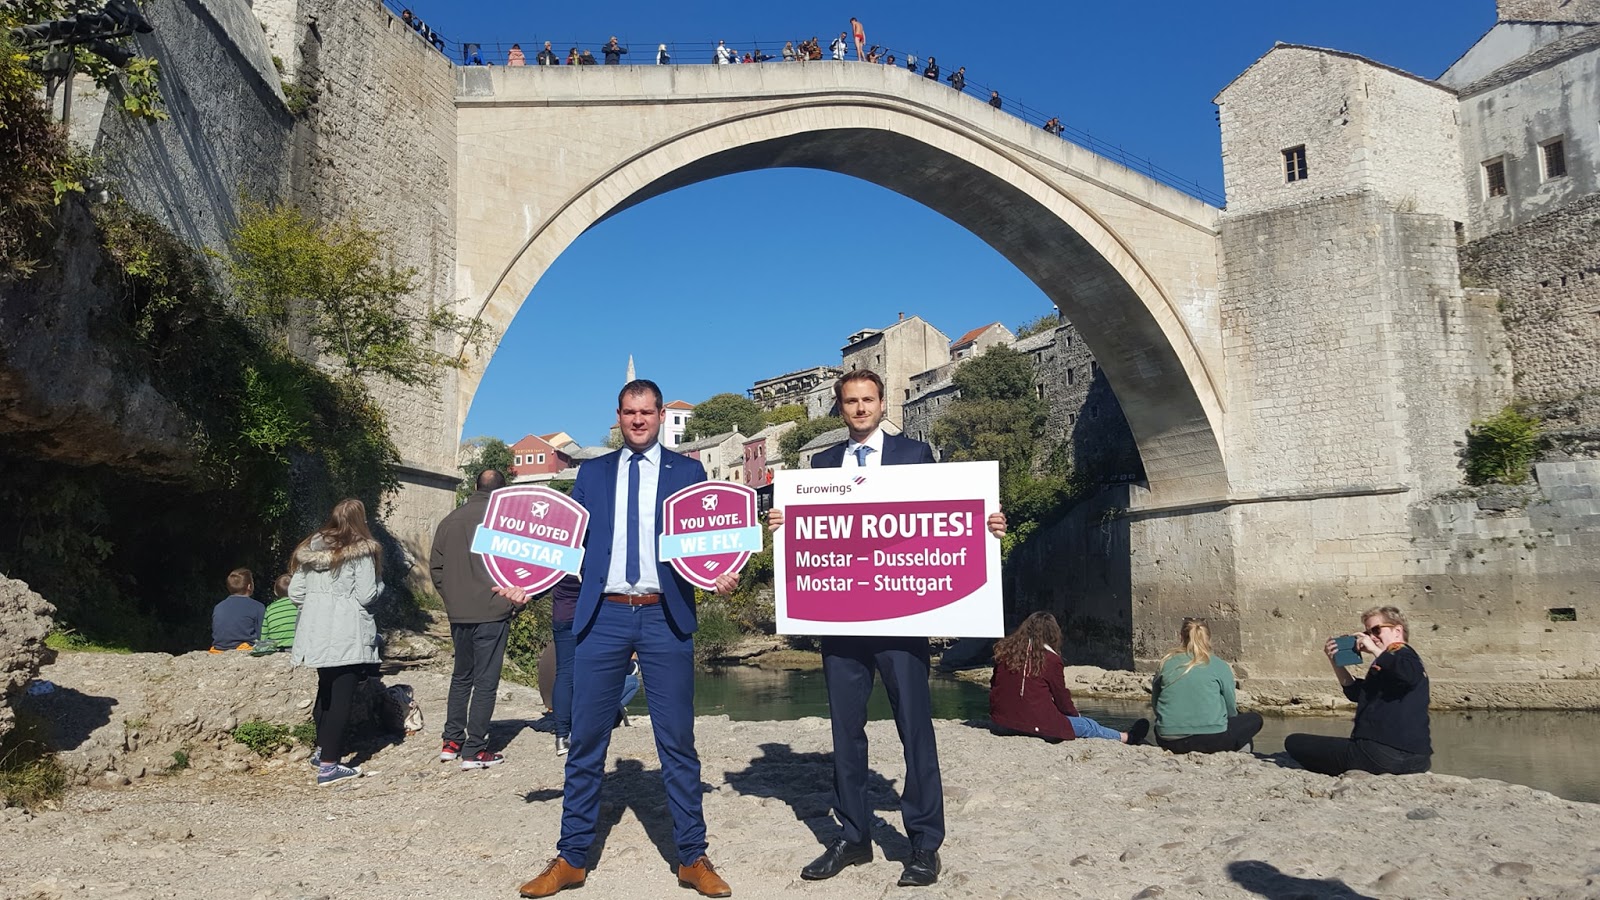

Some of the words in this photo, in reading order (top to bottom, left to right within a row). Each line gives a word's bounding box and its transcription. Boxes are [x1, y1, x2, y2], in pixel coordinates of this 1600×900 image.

[796, 483, 852, 495] Eurowings
[499, 516, 526, 532] YOU
[528, 522, 570, 542] VOTED
[680, 517, 705, 530] YOU
[708, 513, 742, 527] VOTE.
[795, 515, 854, 540] NEW
[861, 511, 974, 539] ROUTES!
[490, 535, 564, 566] MOSTAR
[680, 536, 707, 553] WE
[712, 532, 743, 550] FLY.
[795, 551, 853, 568] Mostar
[873, 547, 967, 567] Dusseldorf
[796, 575, 854, 591] Mostar
[874, 574, 953, 596] Stuttgart
